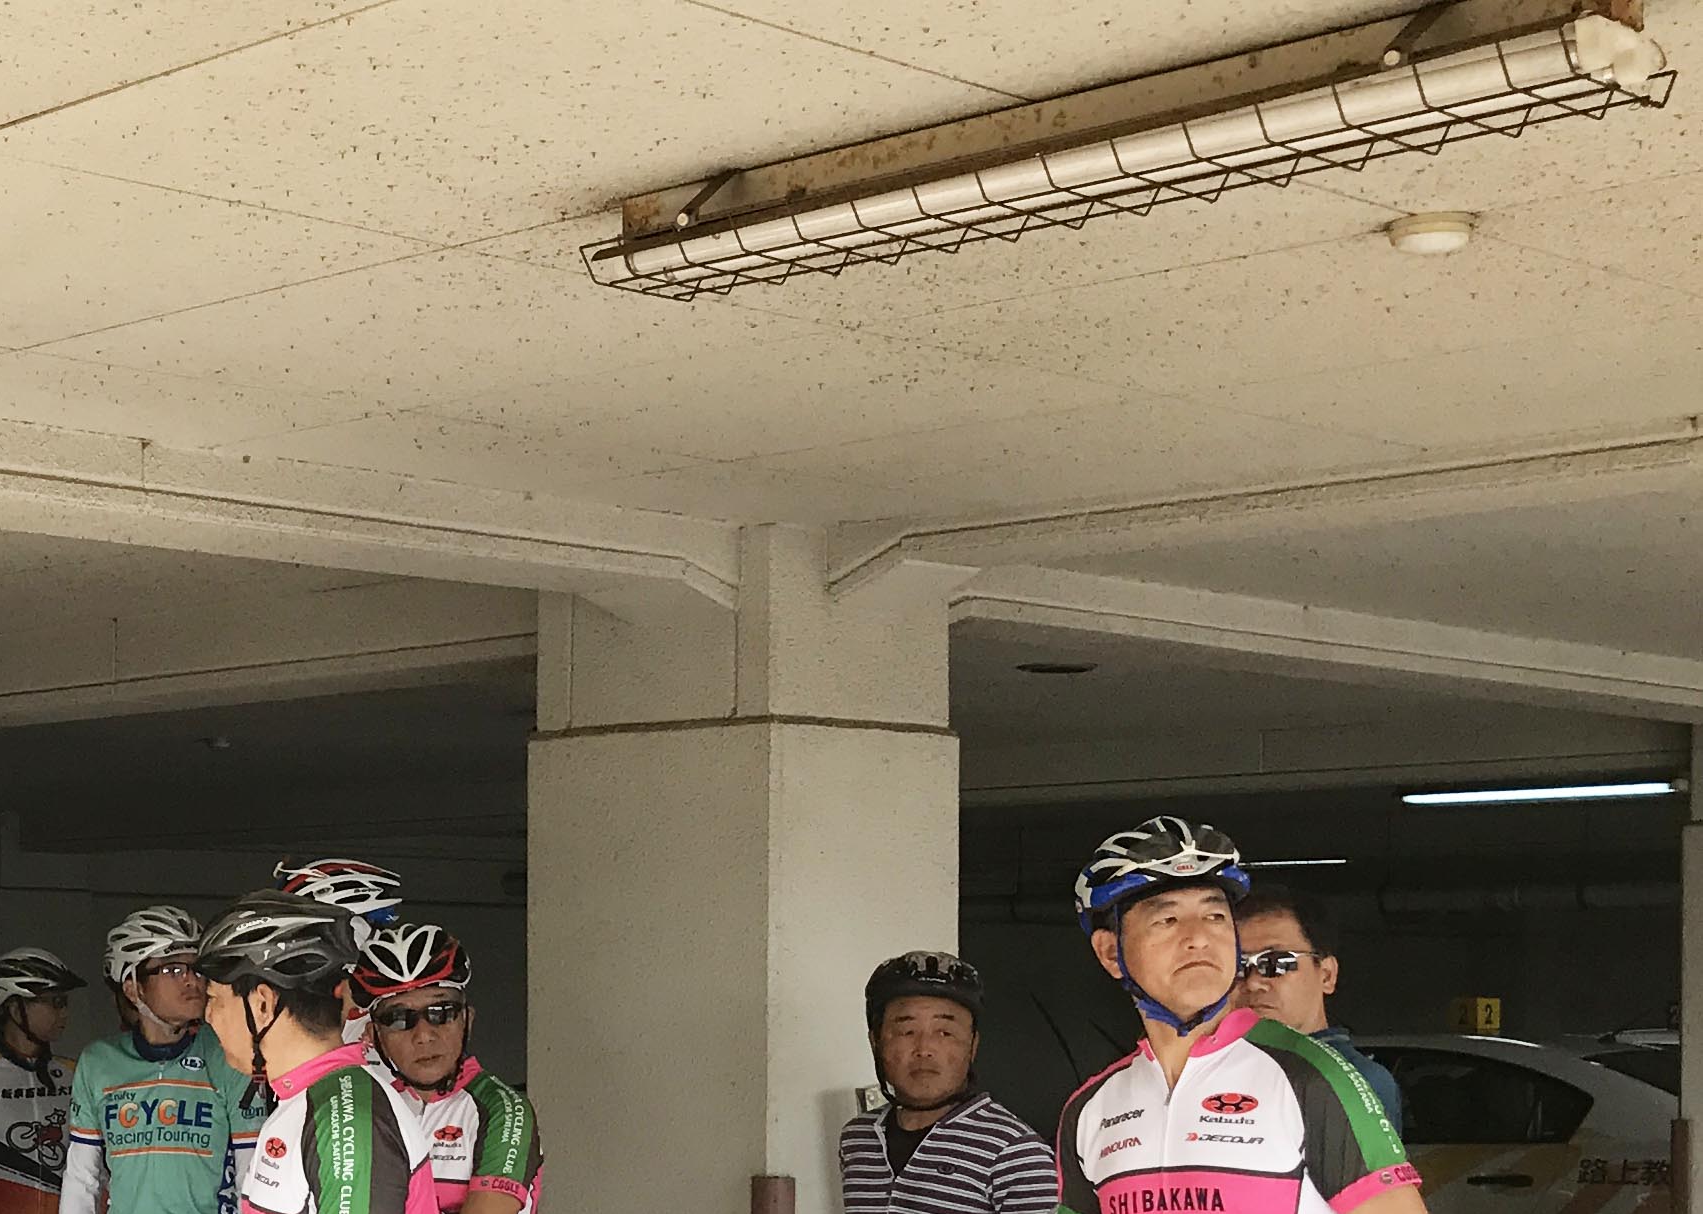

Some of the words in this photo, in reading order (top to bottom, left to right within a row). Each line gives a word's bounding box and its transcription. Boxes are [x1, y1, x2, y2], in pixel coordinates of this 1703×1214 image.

[1484, 1003, 1493, 1025] 2
[104, 1099, 214, 1129] FCYCLE
[510, 1104, 524, 1146] CYCLING
[107, 1131, 153, 1146] Racing
[157, 1126, 211, 1148] Touring
[342, 1126, 355, 1181] CYCLING
[502, 1148, 518, 1174] CLUB
